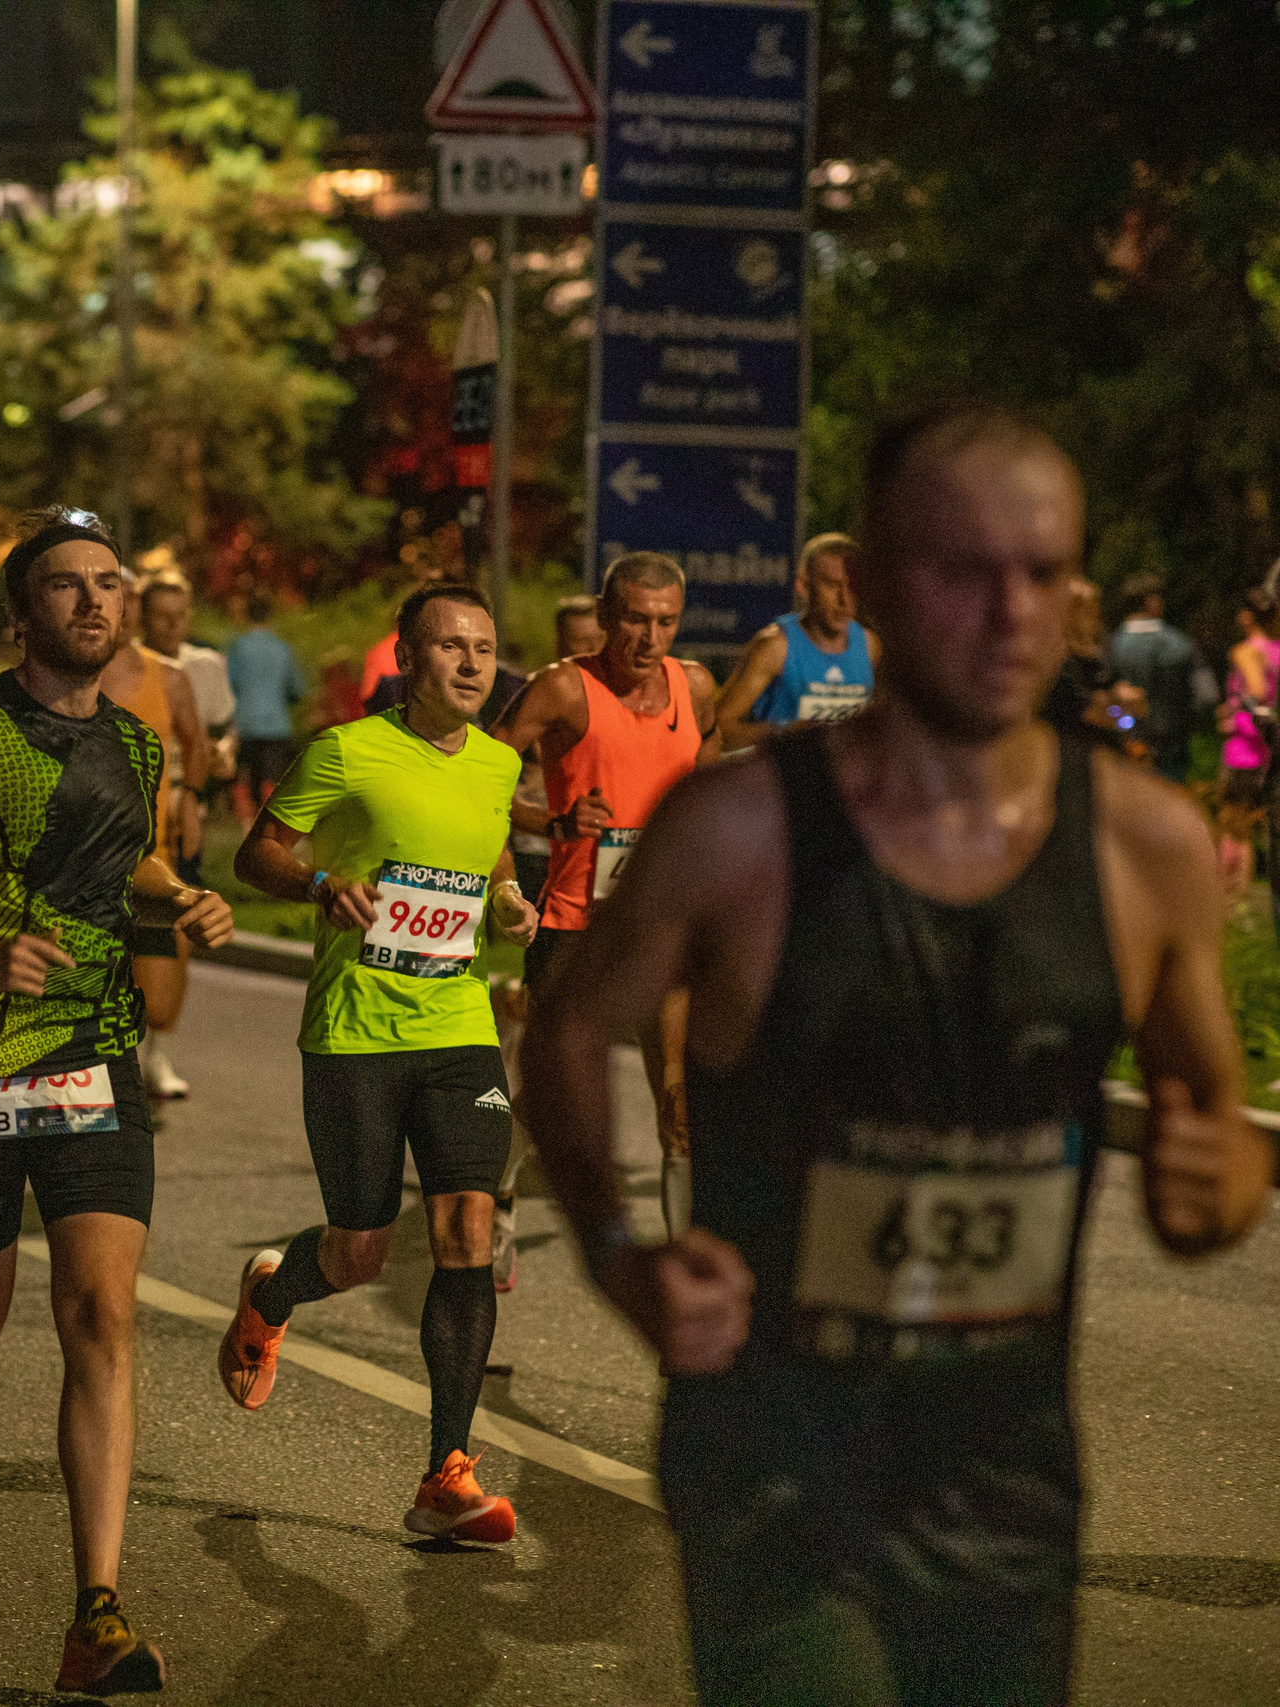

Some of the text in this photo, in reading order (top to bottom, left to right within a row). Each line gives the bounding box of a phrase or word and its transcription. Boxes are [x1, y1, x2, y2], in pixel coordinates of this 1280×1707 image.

[389, 900, 470, 941] 9687
[377, 947, 392, 964] B
[475, 1101, 494, 1110] NIKE
